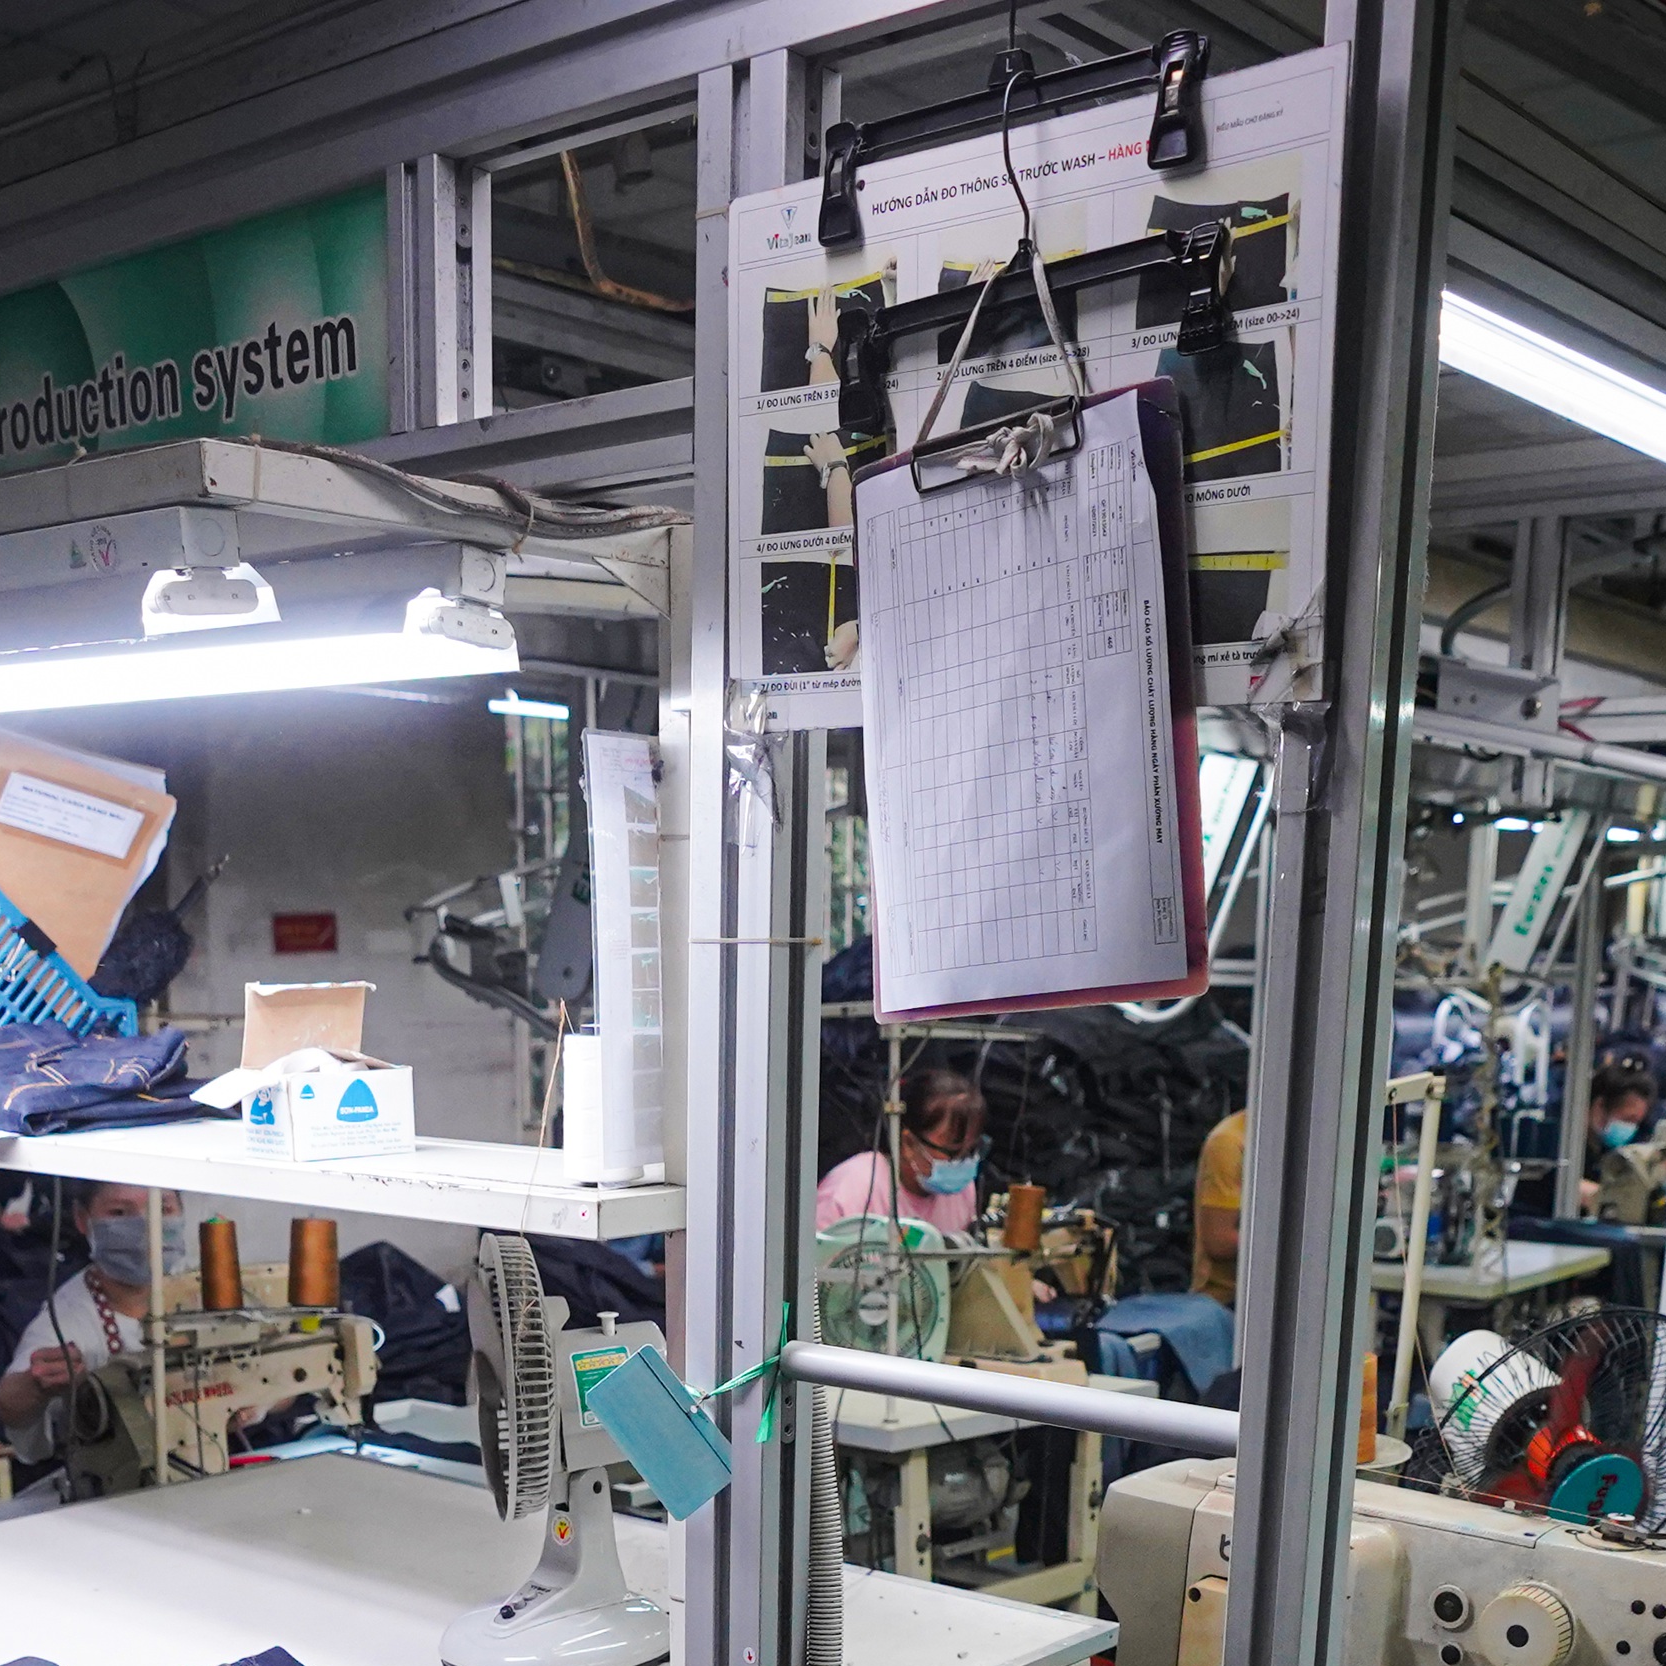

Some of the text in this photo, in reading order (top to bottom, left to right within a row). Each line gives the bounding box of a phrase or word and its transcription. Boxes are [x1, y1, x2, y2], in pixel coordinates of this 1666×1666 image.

[1005, 57, 1013, 73] L
[941, 186, 957, 200] ĐO
[960, 177, 999, 196] THÔNG
[1061, 153, 1096, 173] WASH
[1108, 141, 1143, 161] HÀNG
[1158, 330, 1178, 344] LƯN
[194, 317, 357, 421] system
[1008, 358, 1015, 369] 4
[766, 398, 778, 409] ĐO
[823, 389, 830, 400] 3
[1195, 488, 1225, 502] MÔNG
[766, 542, 778, 552] ĐO
[771, 682, 783, 692] ĐO
[840, 677, 861, 688] đườn
